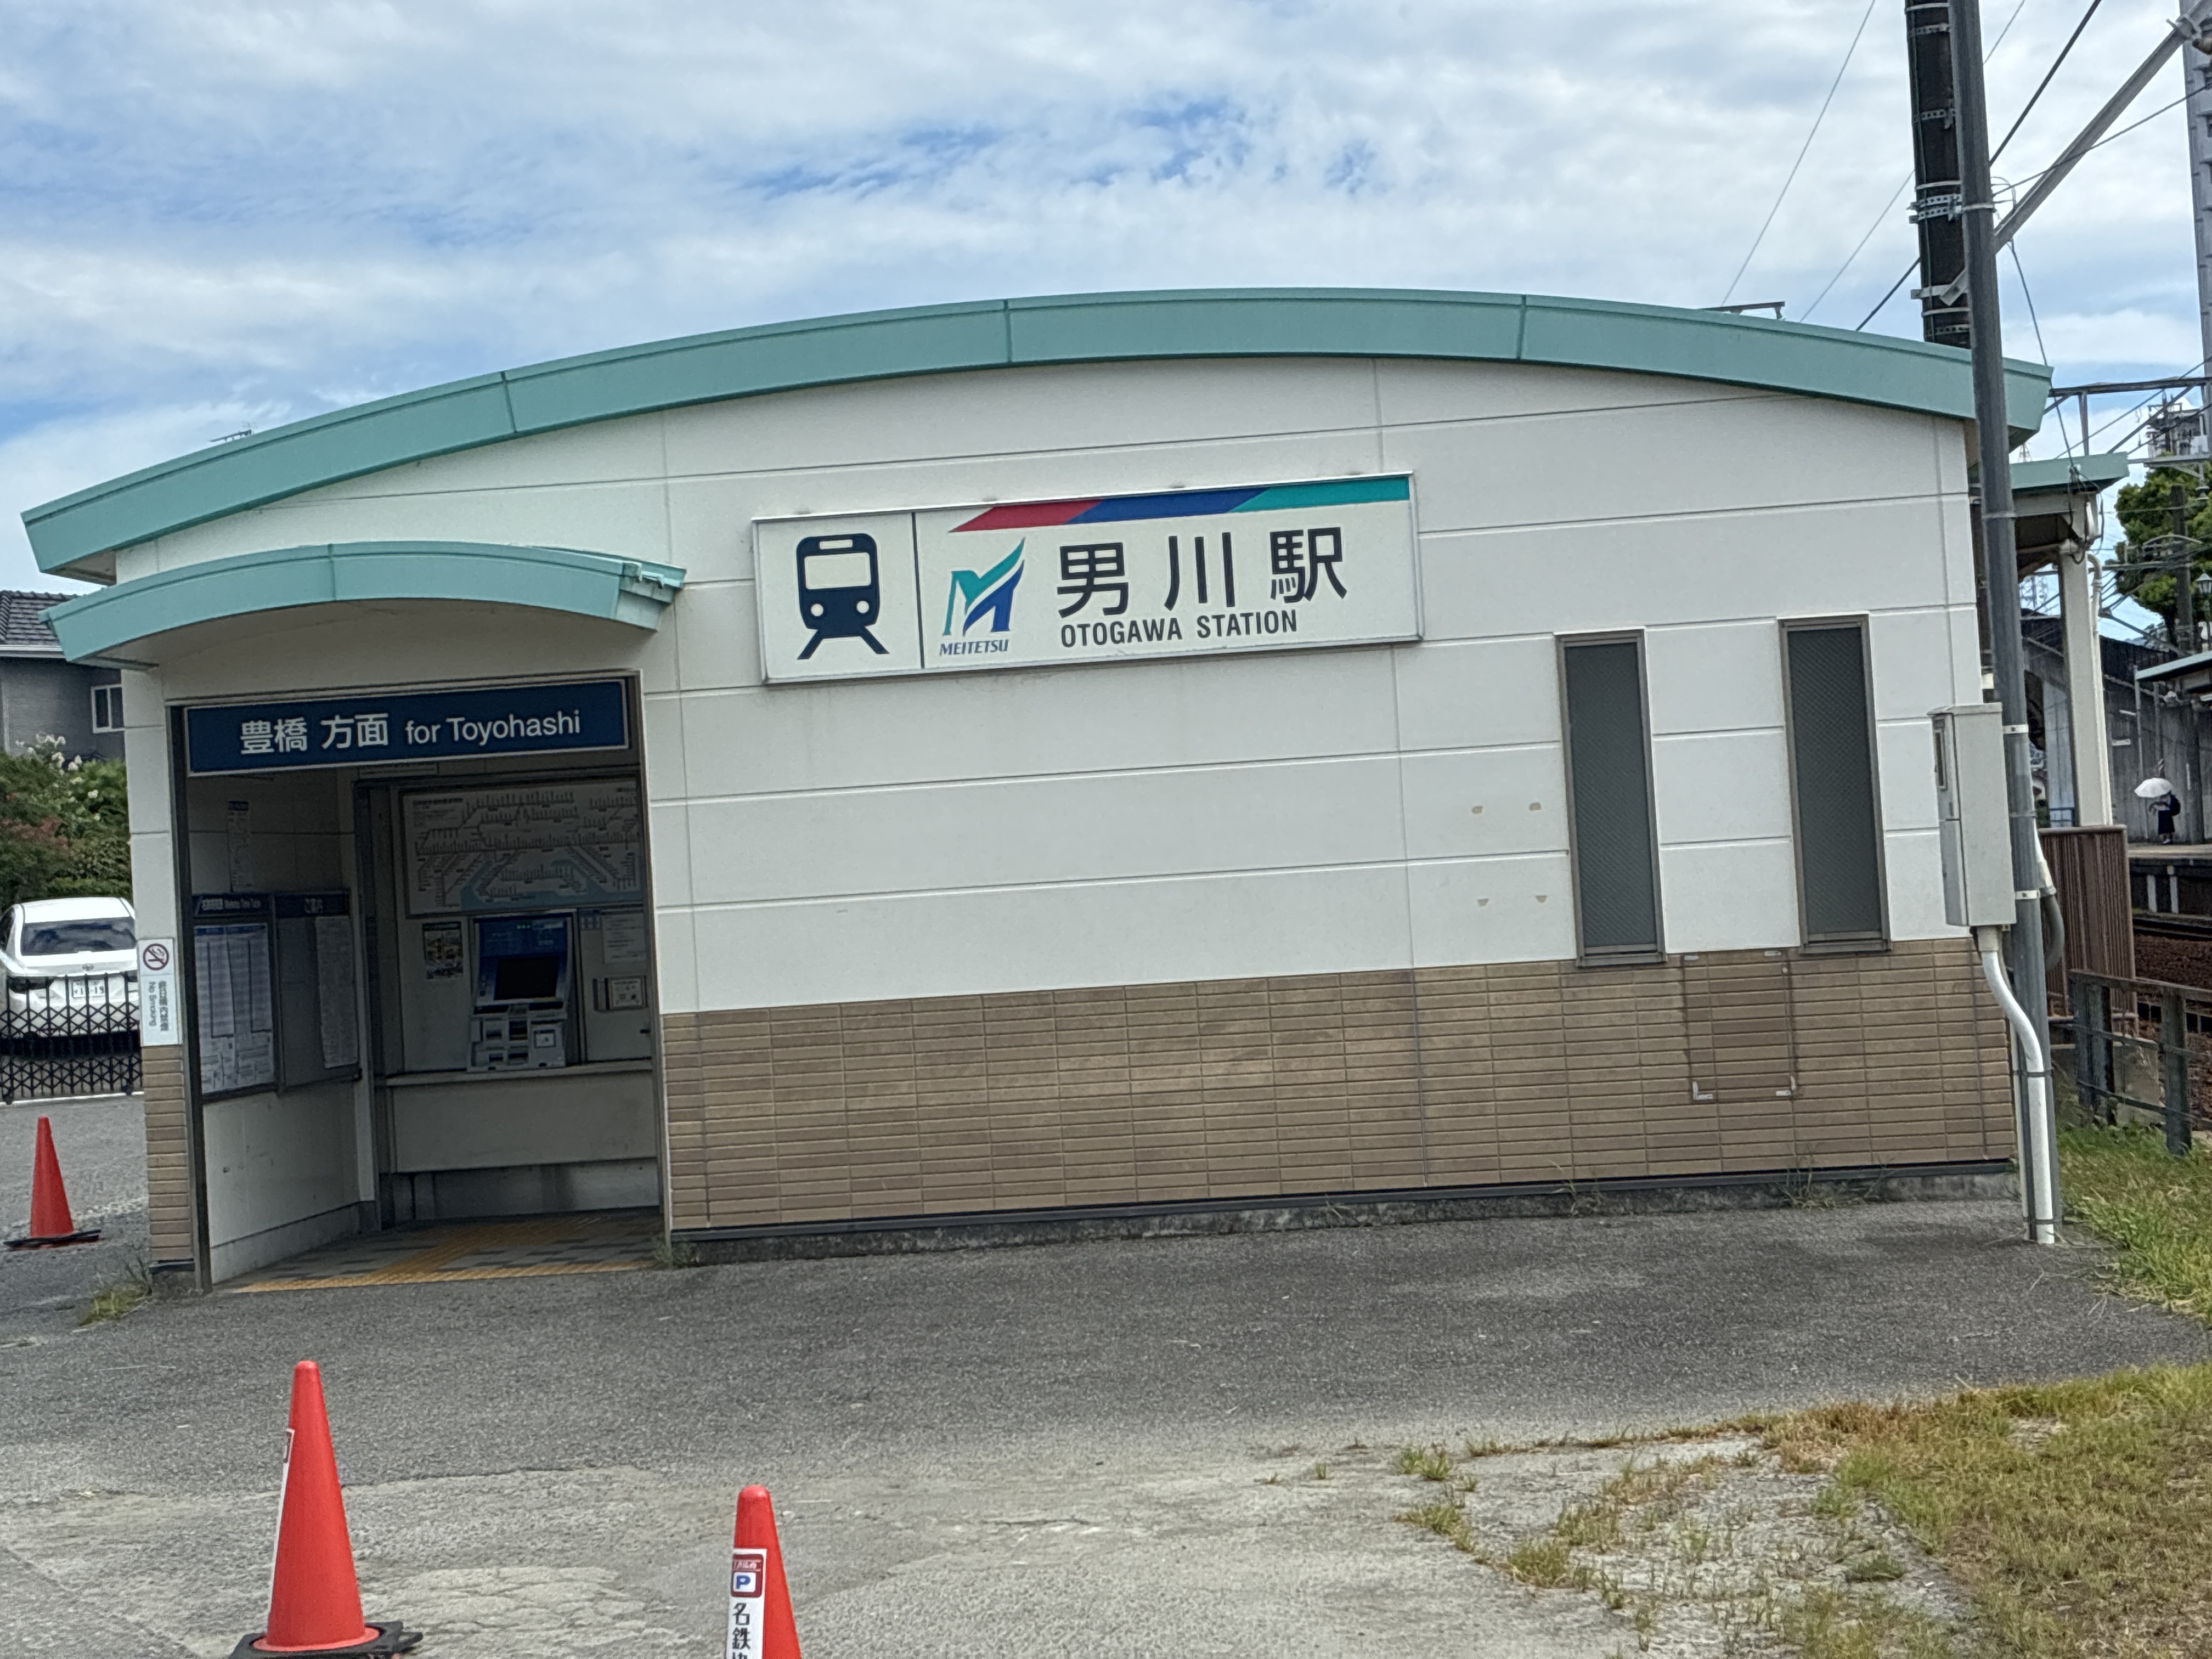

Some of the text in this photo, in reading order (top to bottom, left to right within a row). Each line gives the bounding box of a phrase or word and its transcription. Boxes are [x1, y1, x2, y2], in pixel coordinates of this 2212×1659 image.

[1057, 527, 1347, 618] 男川駅
[939, 639, 1009, 656] MEITETSU
[1061, 609, 1297, 648] OTOGAWA STATION
[240, 709, 580, 755] 豊橋 方面 for Toyohashi
[149, 982, 157, 1026] No Smoking
[736, 1575, 751, 1590] P
